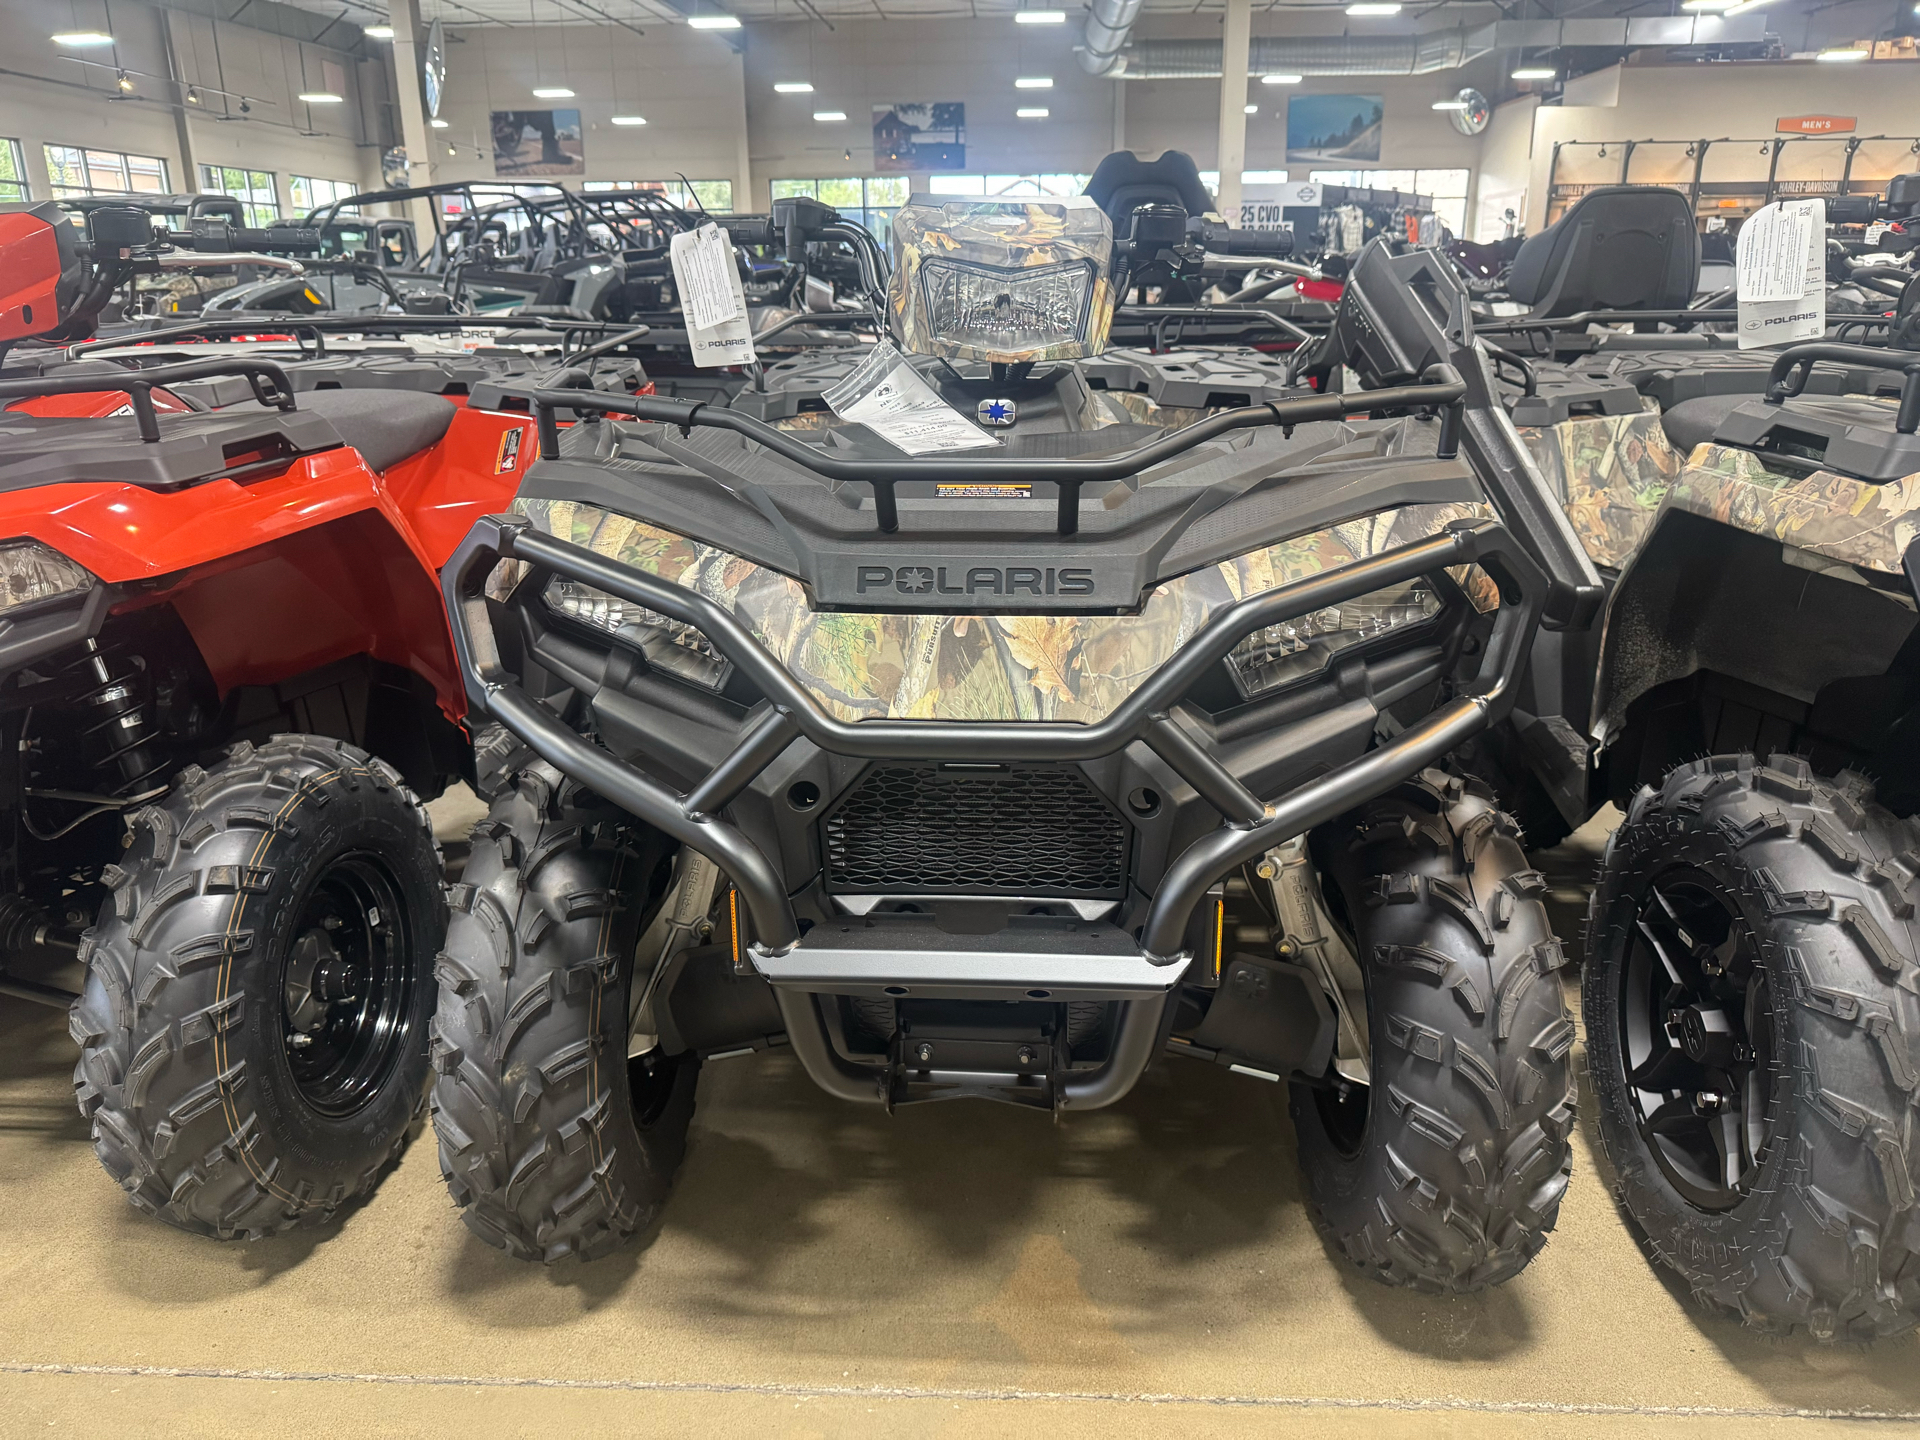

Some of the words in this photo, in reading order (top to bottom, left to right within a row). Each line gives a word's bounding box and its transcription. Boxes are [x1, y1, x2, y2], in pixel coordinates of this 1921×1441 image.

[1802, 121, 1831, 129] MEN'S
[1779, 181, 1839, 193] HARLEY-DAVIDSON
[1258, 205, 1280, 223] CVO
[1764, 312, 1817, 326] POLARIS
[708, 338, 746, 347] POLARIS
[856, 566, 1095, 596] POLARIS
[680, 858, 702, 917] POLARIS
[1290, 874, 1315, 938] POLARIS
